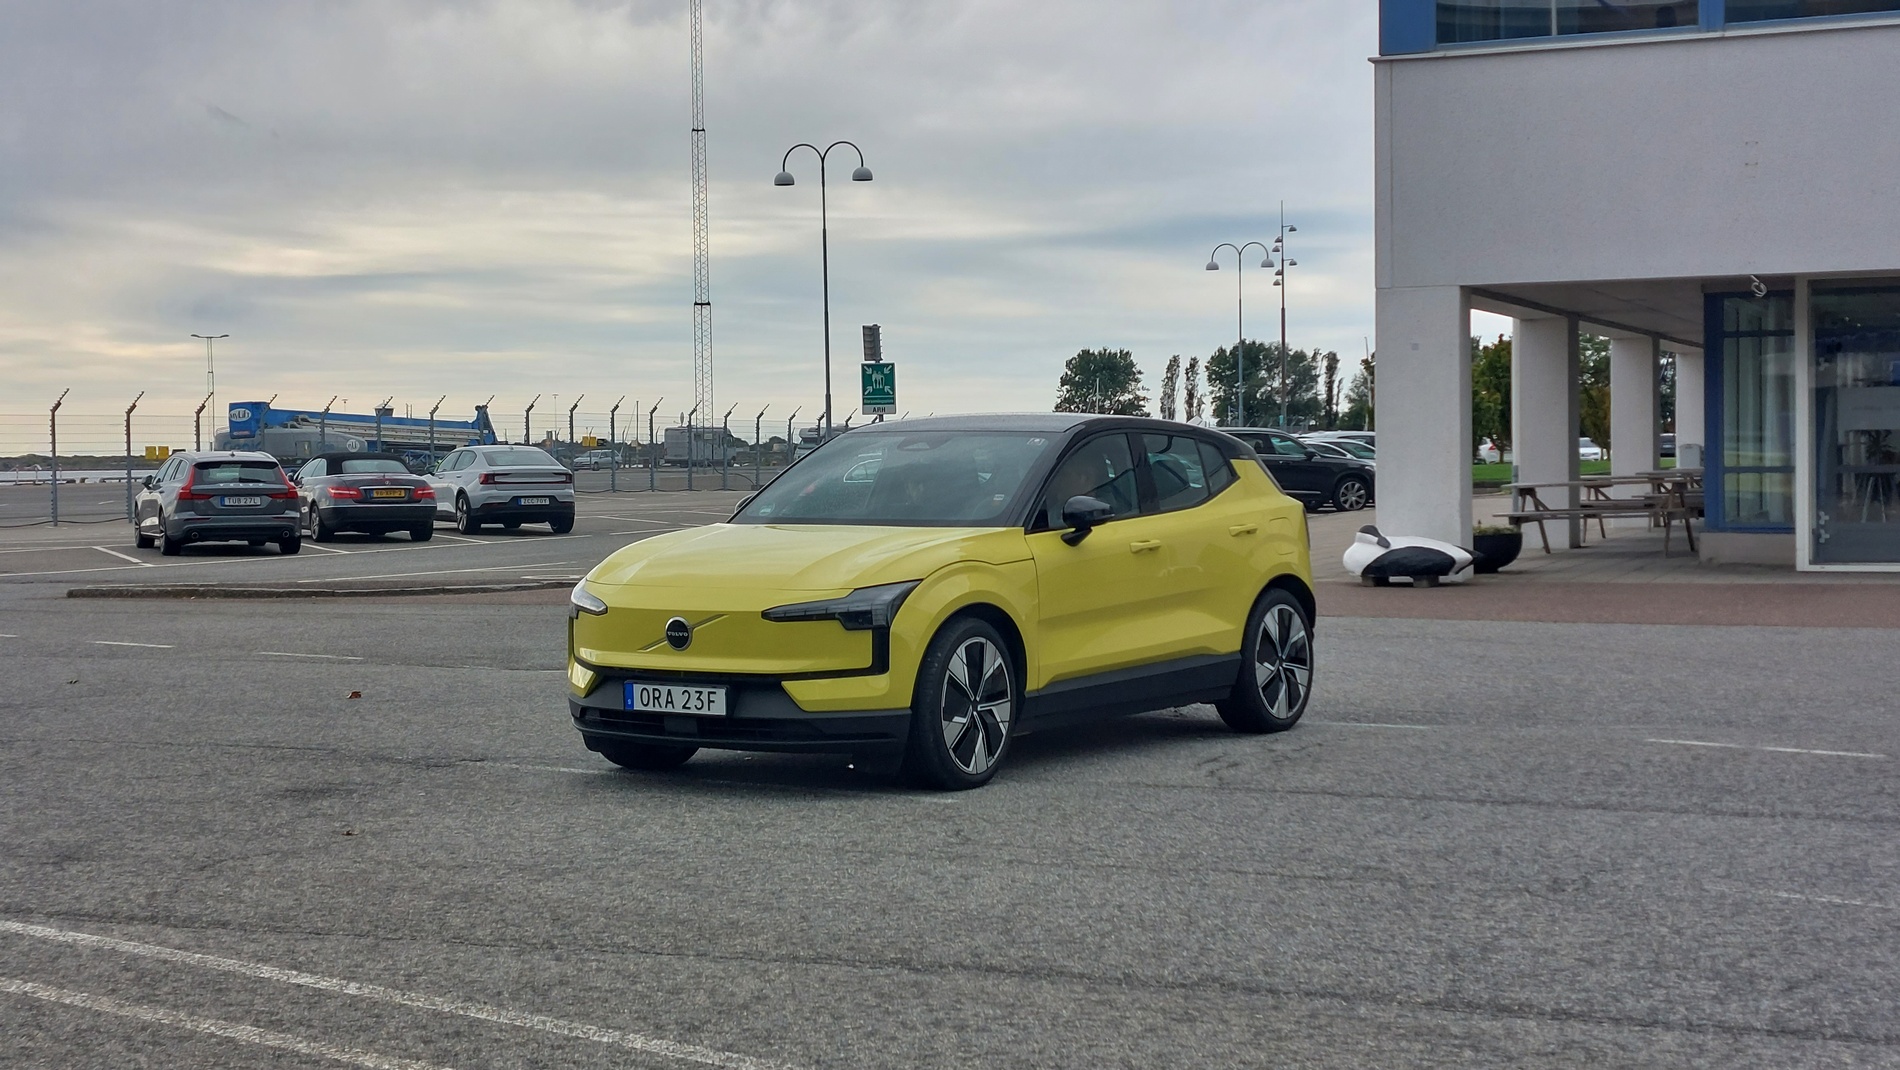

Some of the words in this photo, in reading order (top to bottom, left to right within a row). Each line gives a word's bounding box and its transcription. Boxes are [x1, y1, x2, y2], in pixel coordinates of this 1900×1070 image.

[243, 497, 257, 505] 27L
[640, 687, 675, 709] ORA
[681, 689, 717, 711] 23F
